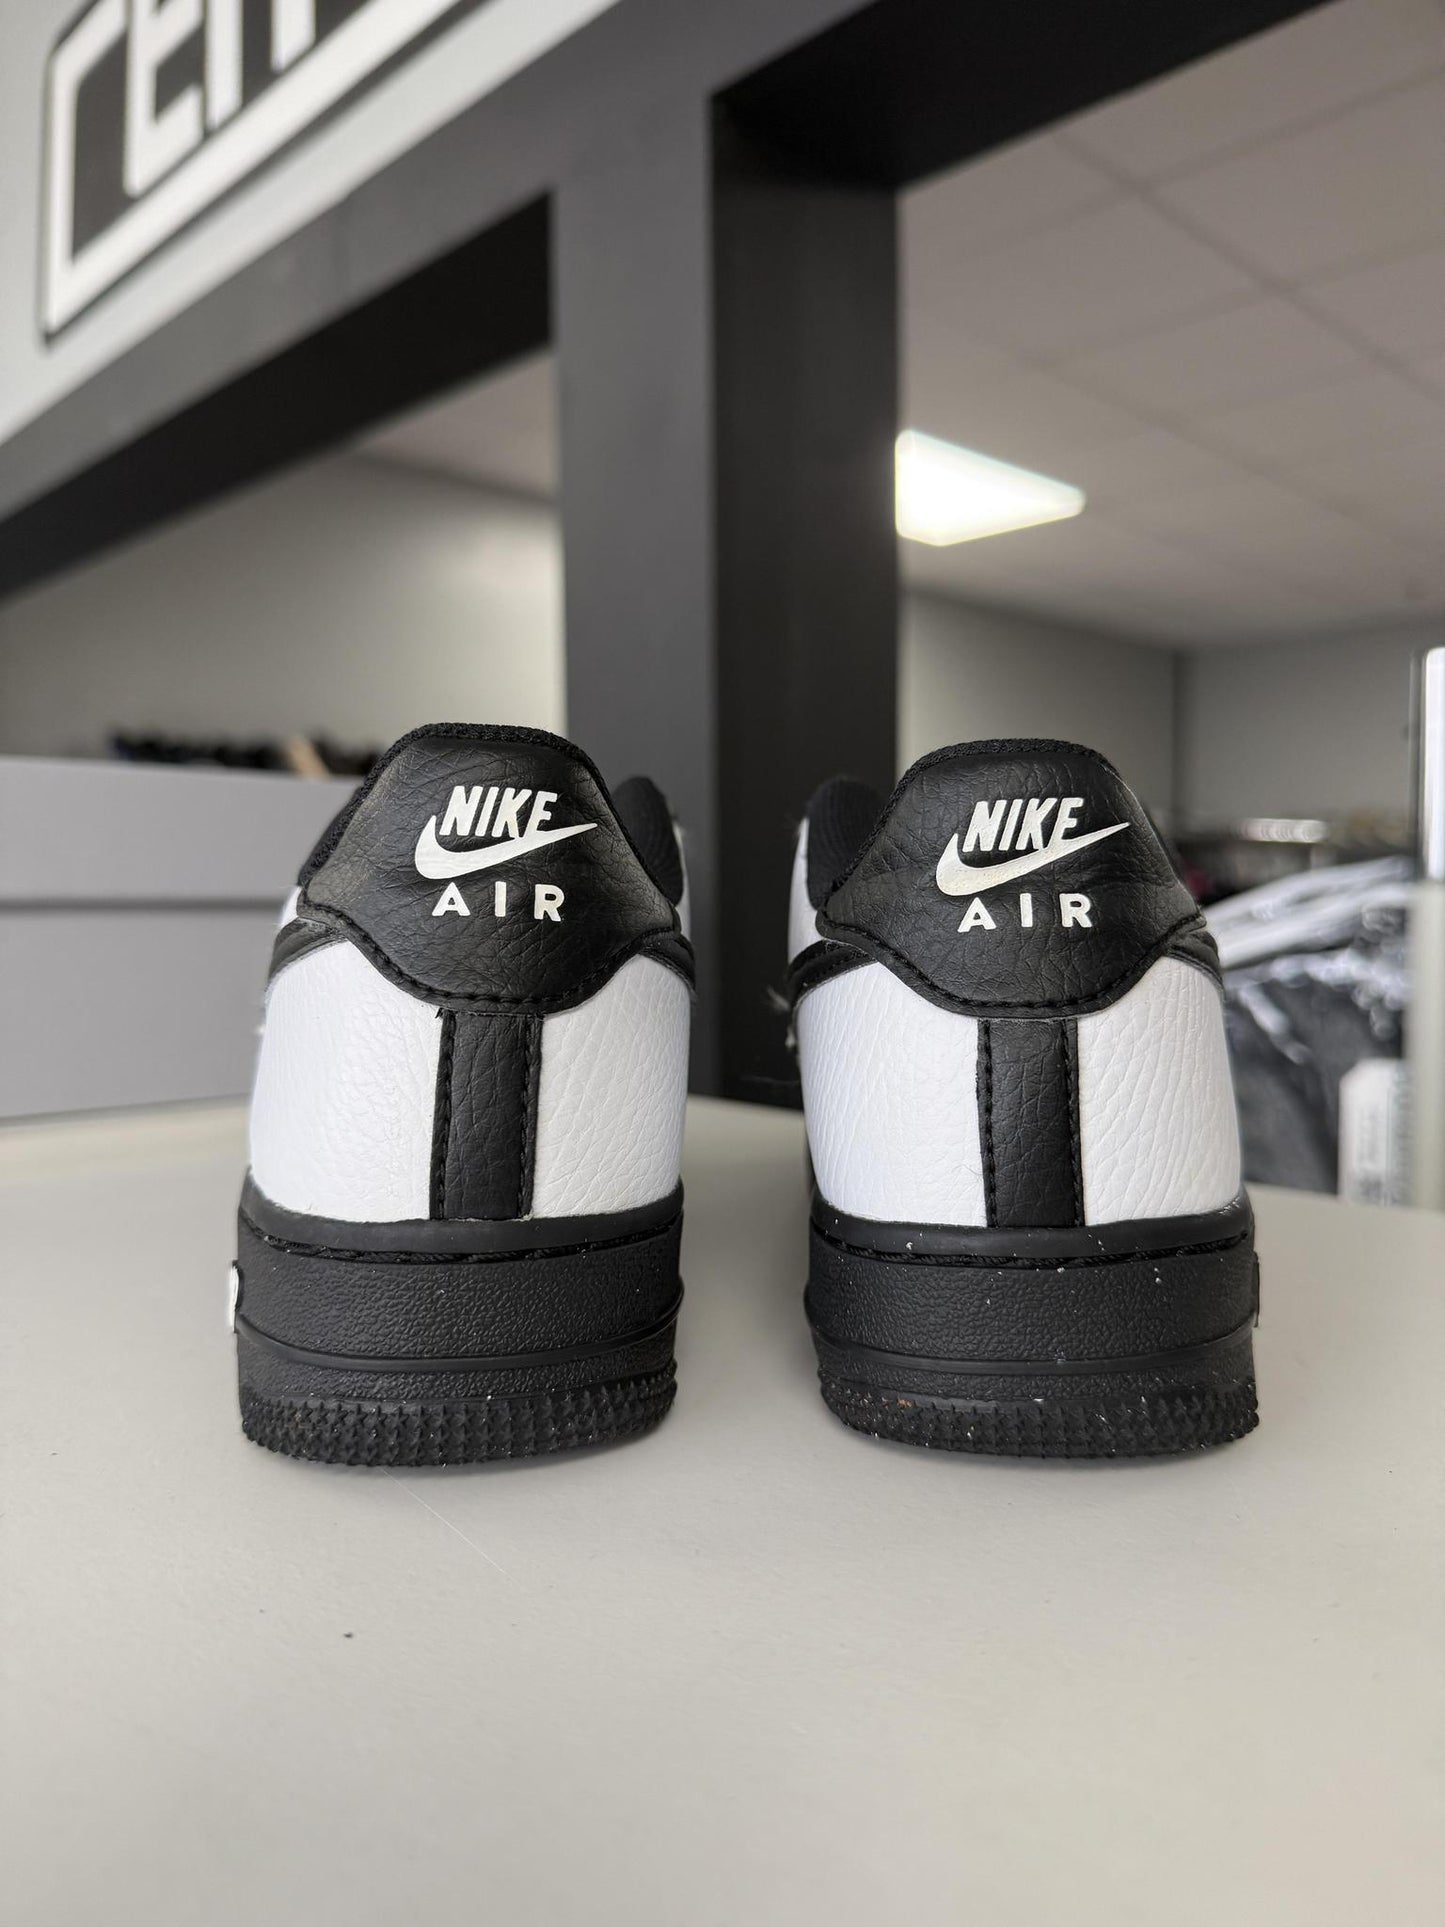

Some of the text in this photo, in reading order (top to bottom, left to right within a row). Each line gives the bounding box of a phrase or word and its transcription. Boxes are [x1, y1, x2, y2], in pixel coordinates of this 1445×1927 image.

[439, 785, 558, 838] NIKE
[962, 797, 1084, 852] NIKE
[432, 881, 565, 922] AIR
[957, 893, 1092, 933] AIR
